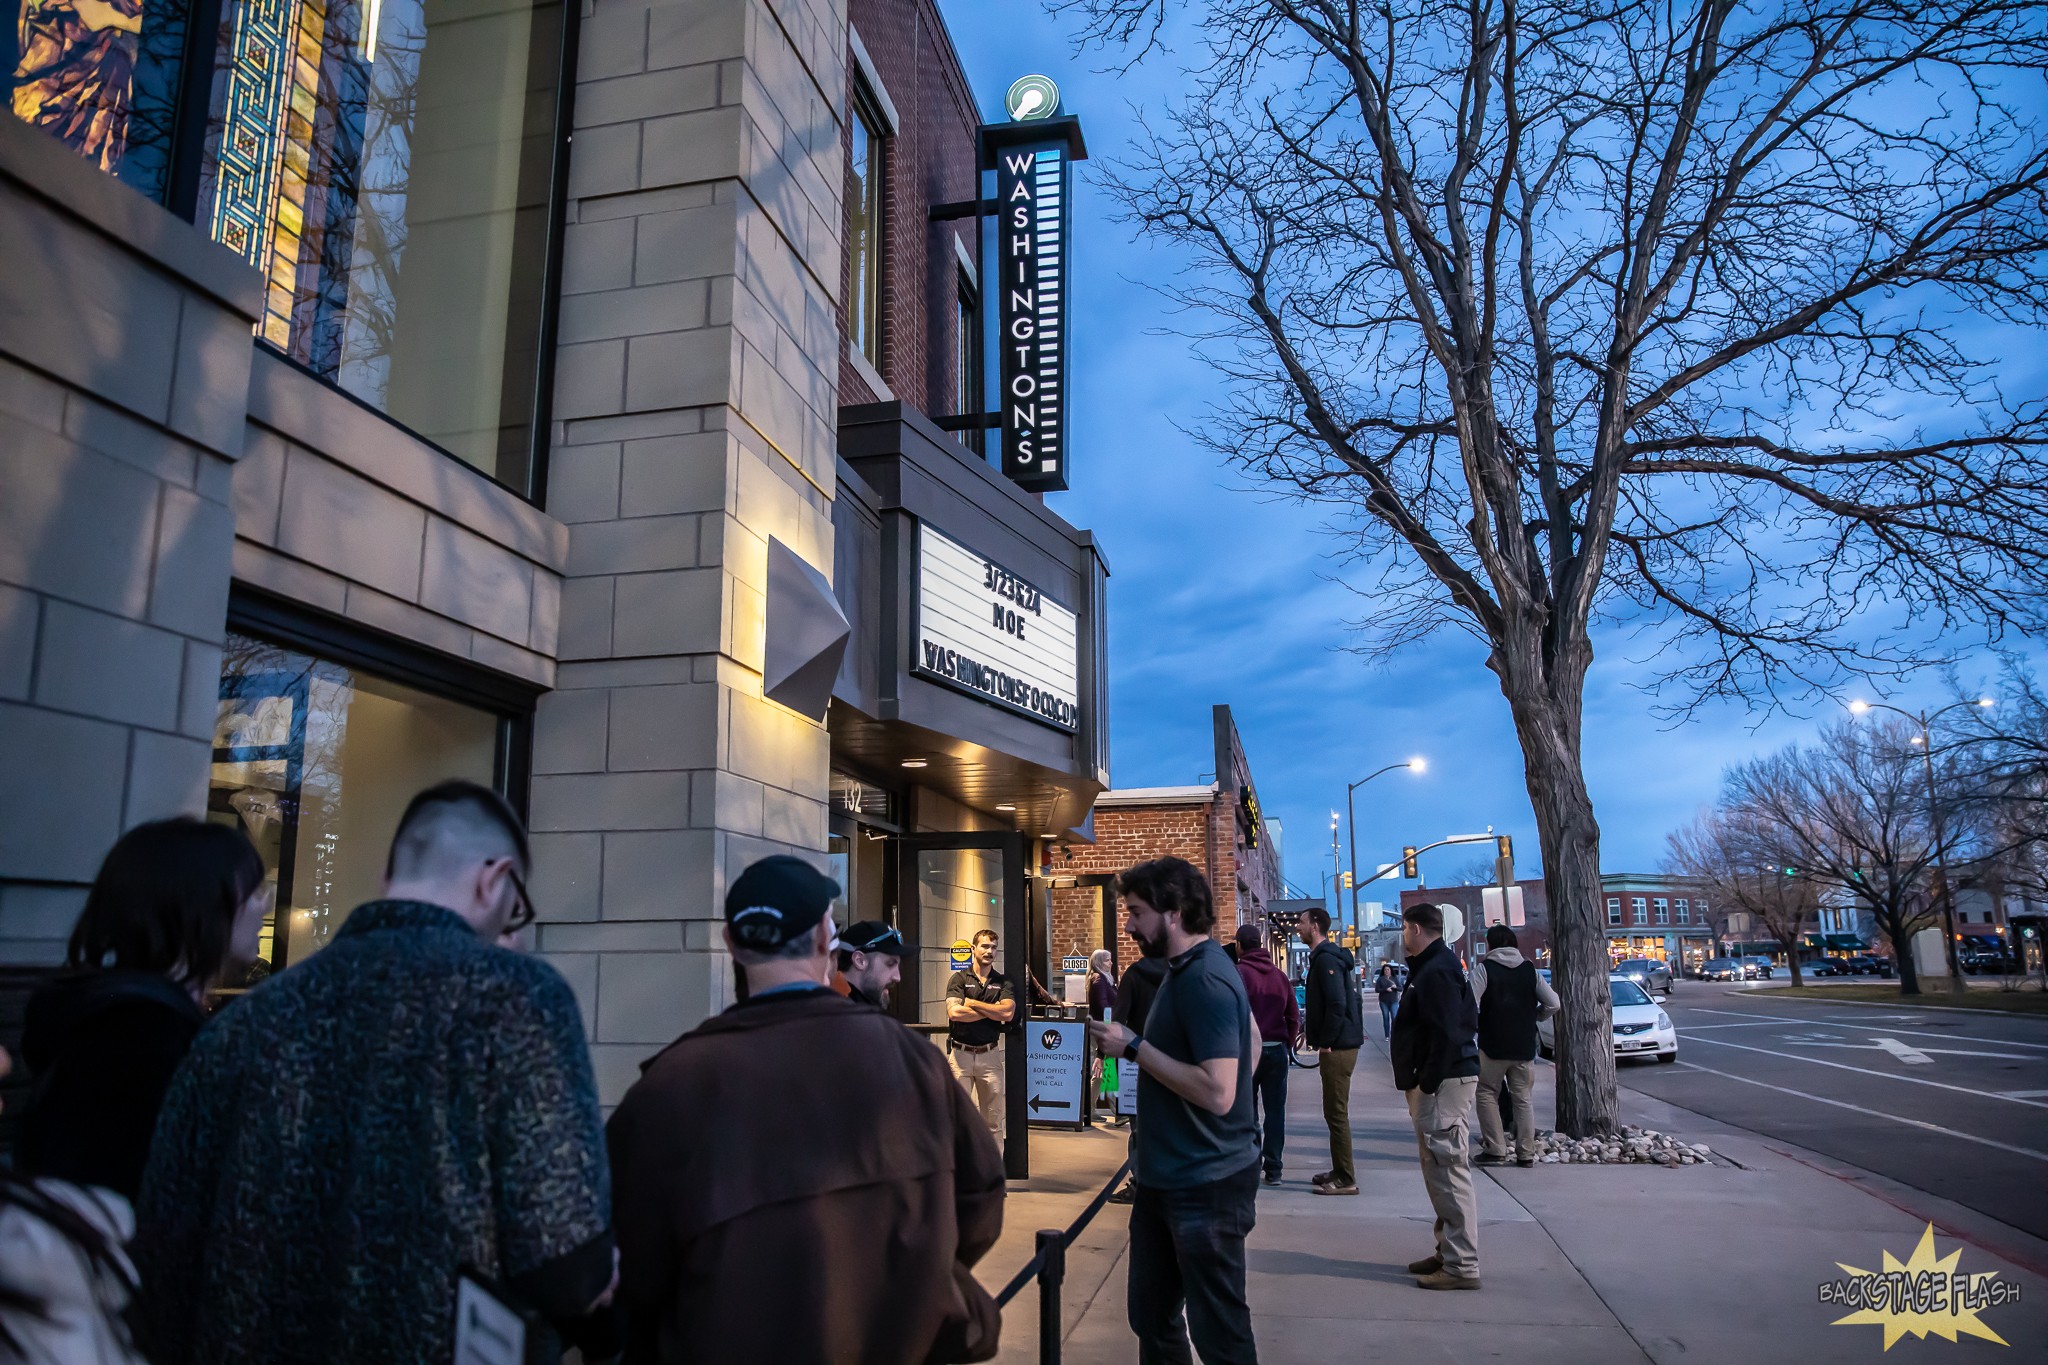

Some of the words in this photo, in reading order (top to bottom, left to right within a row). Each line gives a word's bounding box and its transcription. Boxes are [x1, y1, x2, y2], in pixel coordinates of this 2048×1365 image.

[1006, 152, 1036, 465] WASHINGTON'S
[993, 602, 1025, 641] NOE
[845, 778, 861, 813] 132
[1064, 959, 1087, 968] CLOSED
